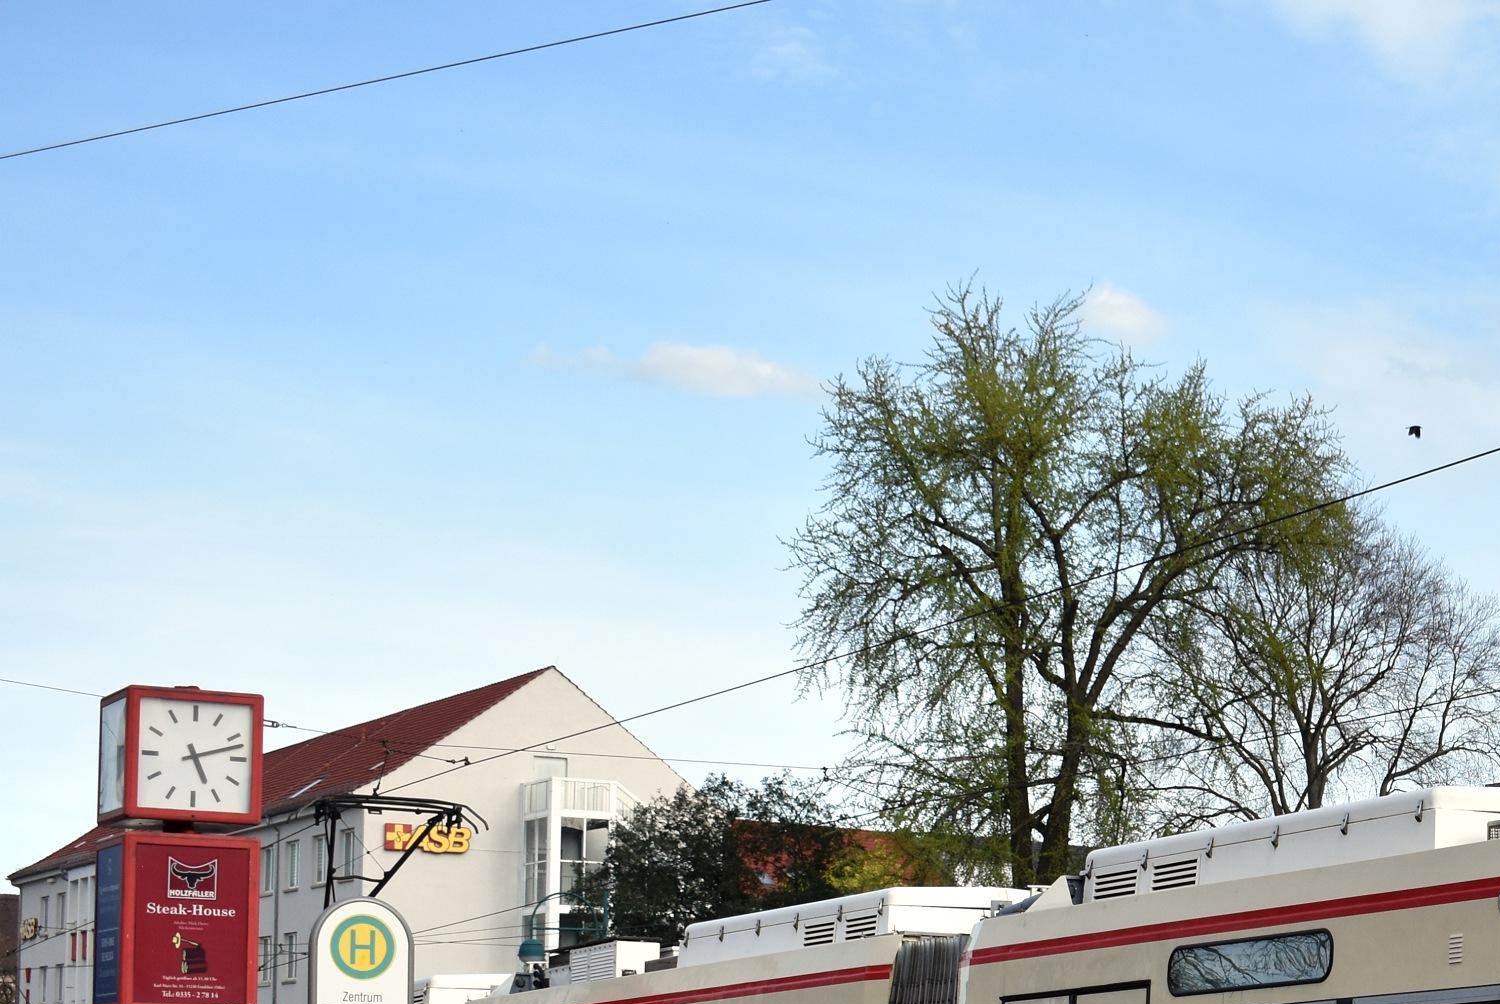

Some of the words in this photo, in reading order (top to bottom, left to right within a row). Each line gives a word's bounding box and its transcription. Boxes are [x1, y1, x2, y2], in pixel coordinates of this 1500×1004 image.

[146, 902, 236, 917] Steak-House
[350, 929, 375, 965] H
[342, 991, 383, 1003] Zentrum
